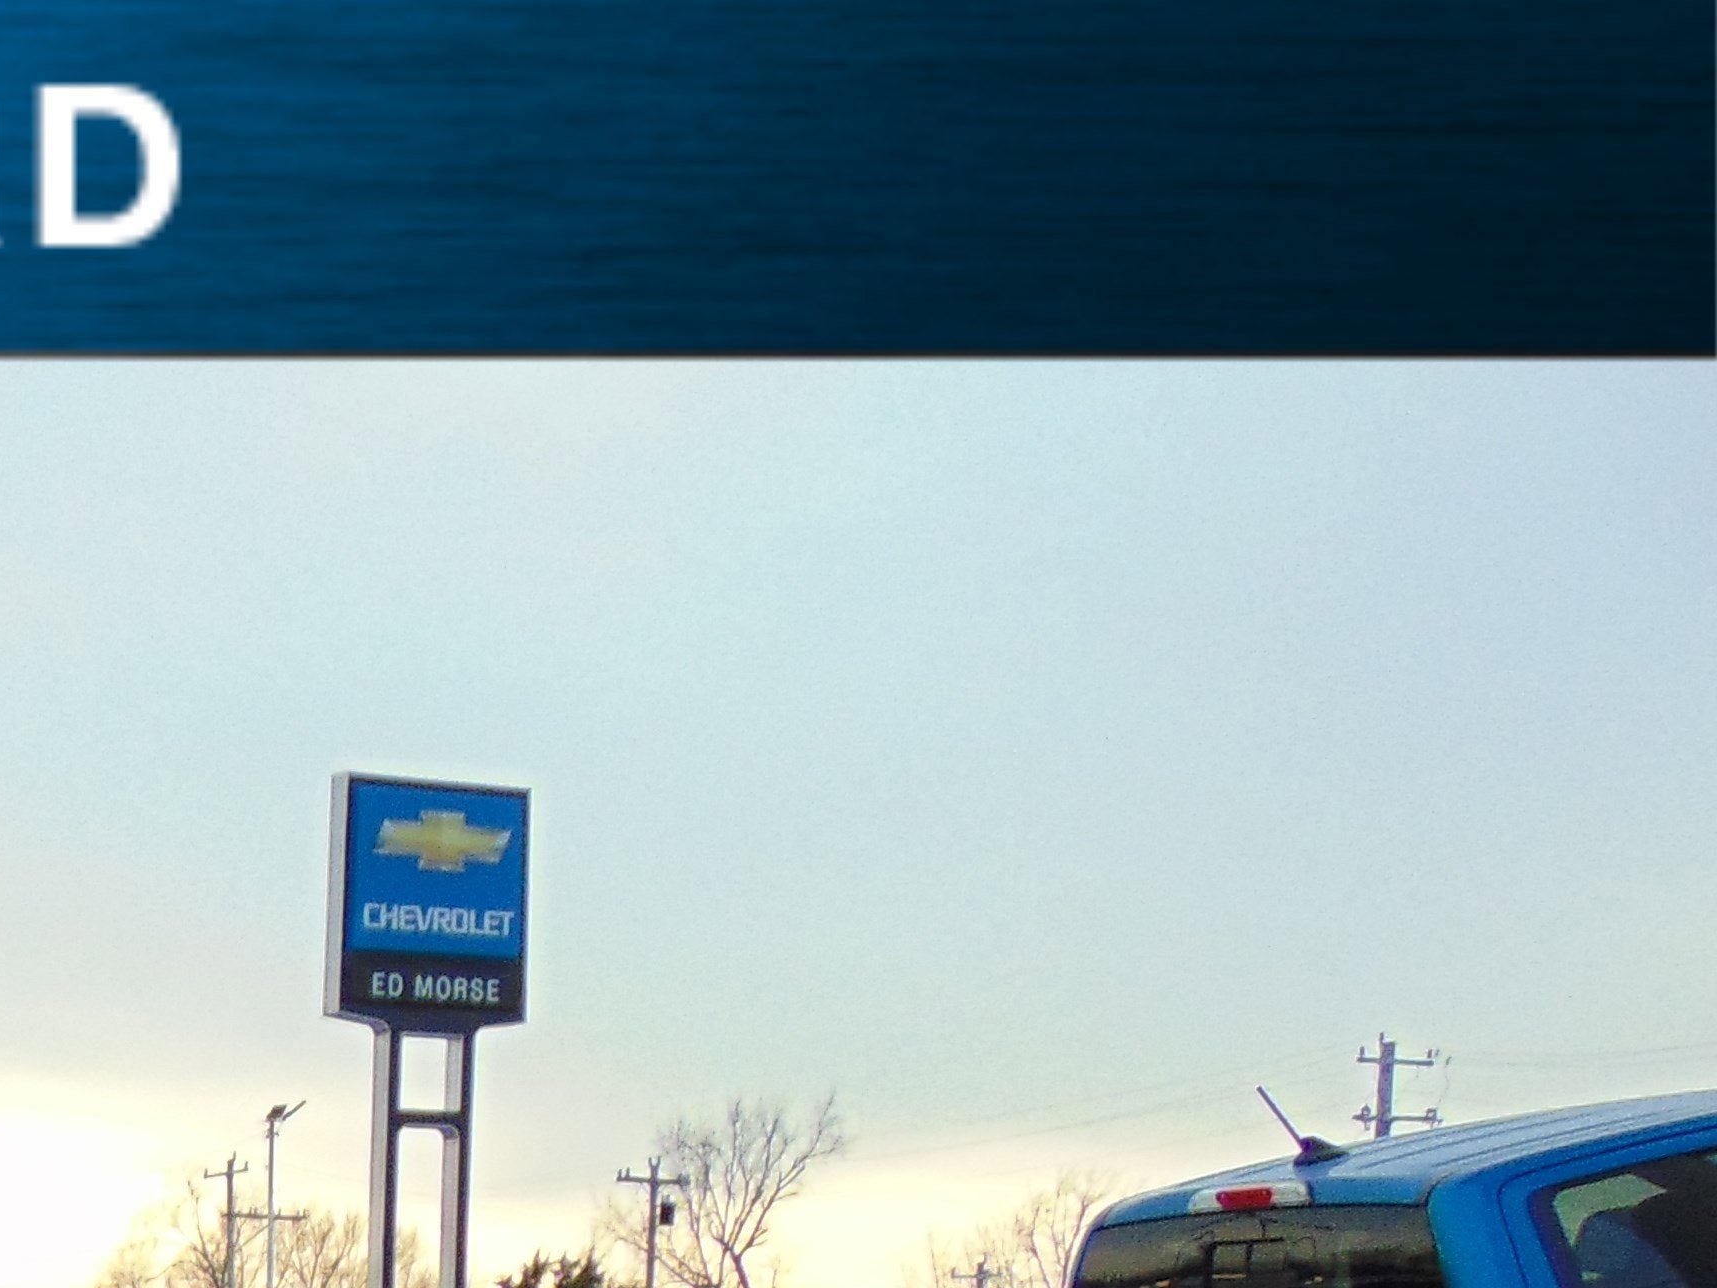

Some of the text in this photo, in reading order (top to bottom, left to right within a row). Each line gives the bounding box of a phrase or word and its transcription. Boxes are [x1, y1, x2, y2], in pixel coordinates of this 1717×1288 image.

[363, 902, 515, 936] CHEVROLET
[370, 971, 500, 1003] ED MORSE
